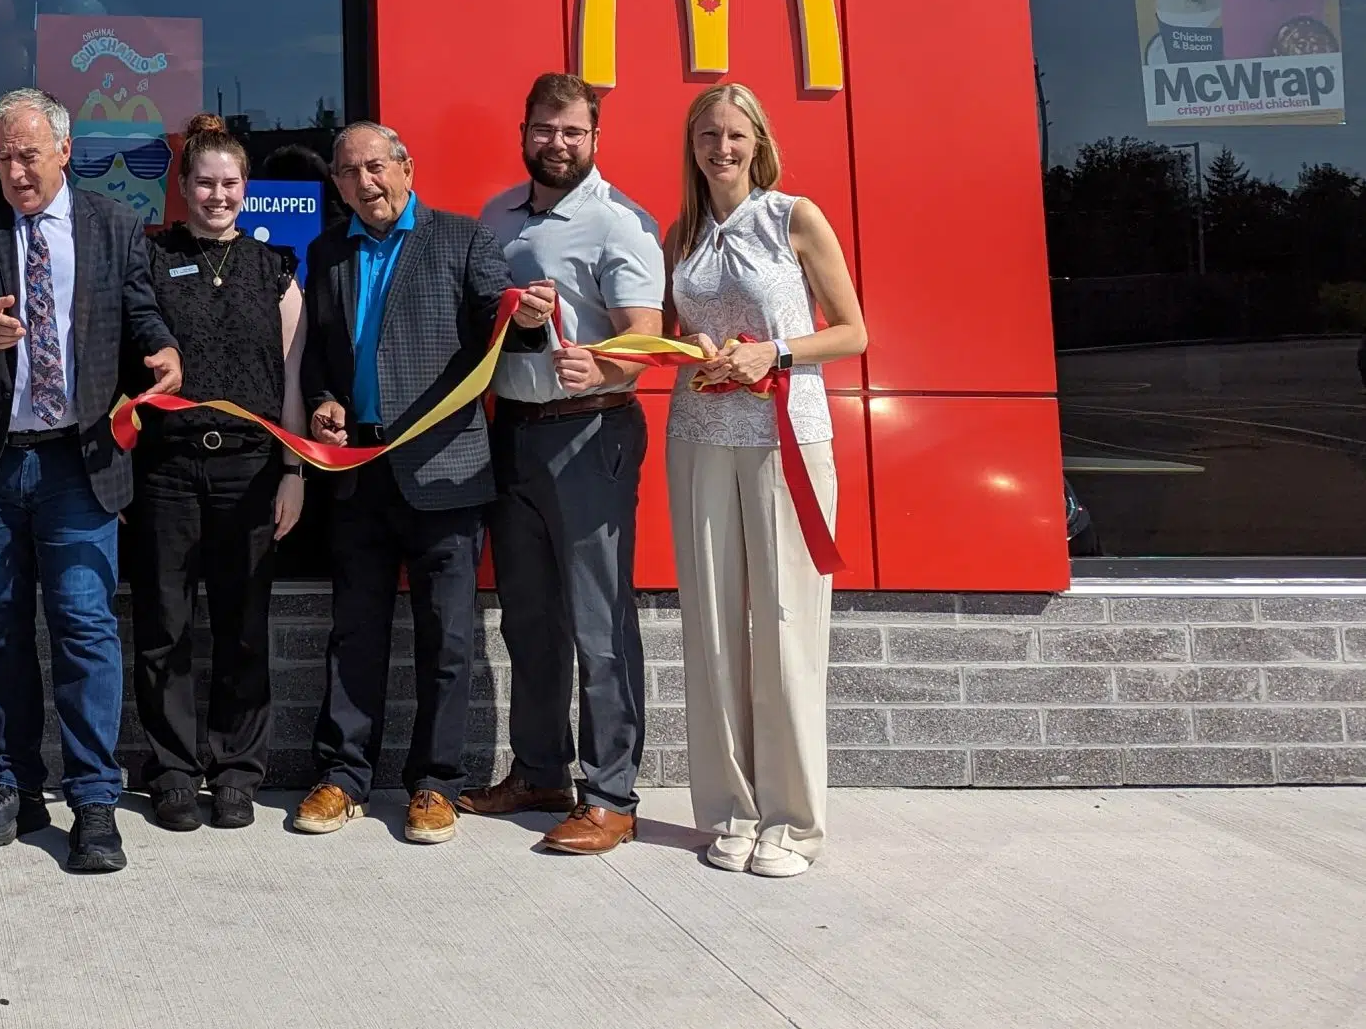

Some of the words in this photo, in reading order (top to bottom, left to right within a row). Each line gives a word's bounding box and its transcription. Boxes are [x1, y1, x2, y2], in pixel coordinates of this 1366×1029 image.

[82, 28, 116, 41] ORIGINAL
[1172, 31, 1213, 43] Chicken
[1172, 41, 1181, 50] &
[1182, 42, 1213, 51] Bacon
[1154, 61, 1336, 106] McWrap
[1177, 104, 1212, 116] crispy
[1214, 104, 1225, 113] or
[1227, 100, 1263, 114] grilled
[1265, 98, 1310, 110] chicken
[240, 197, 316, 213] NDICAPPED
